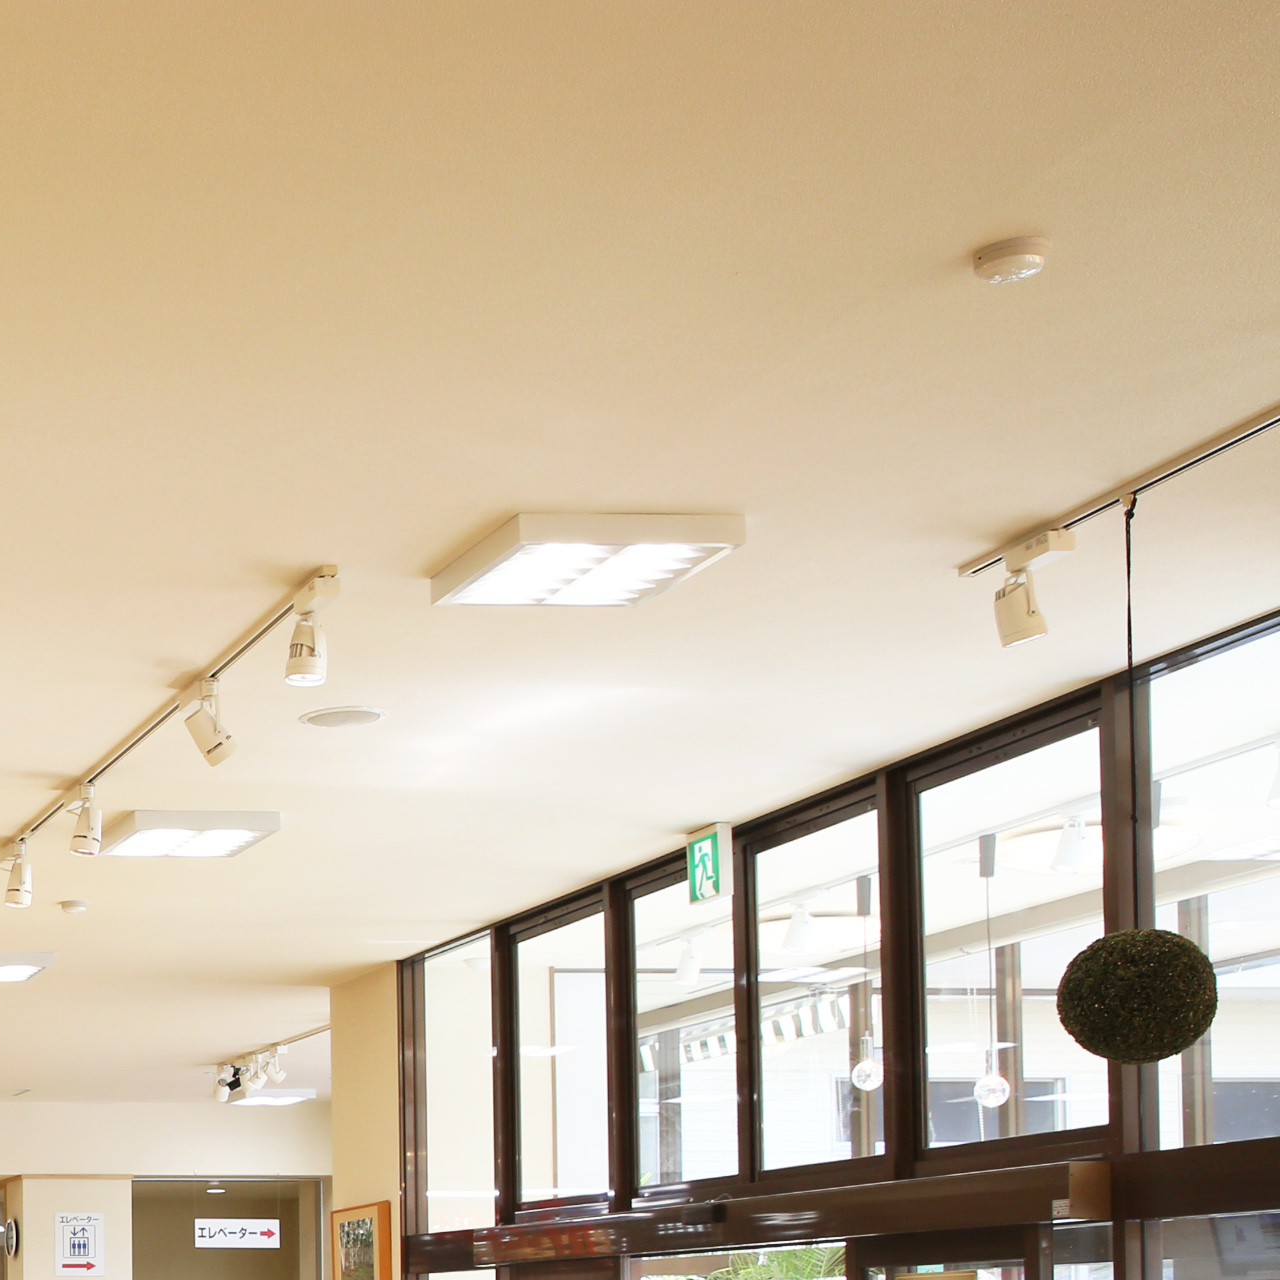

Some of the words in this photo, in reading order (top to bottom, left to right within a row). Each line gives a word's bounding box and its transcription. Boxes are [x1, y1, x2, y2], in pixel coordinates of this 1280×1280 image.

[59, 1215, 99, 1224] エレベーター
[197, 1226, 258, 1240] エレベーター
